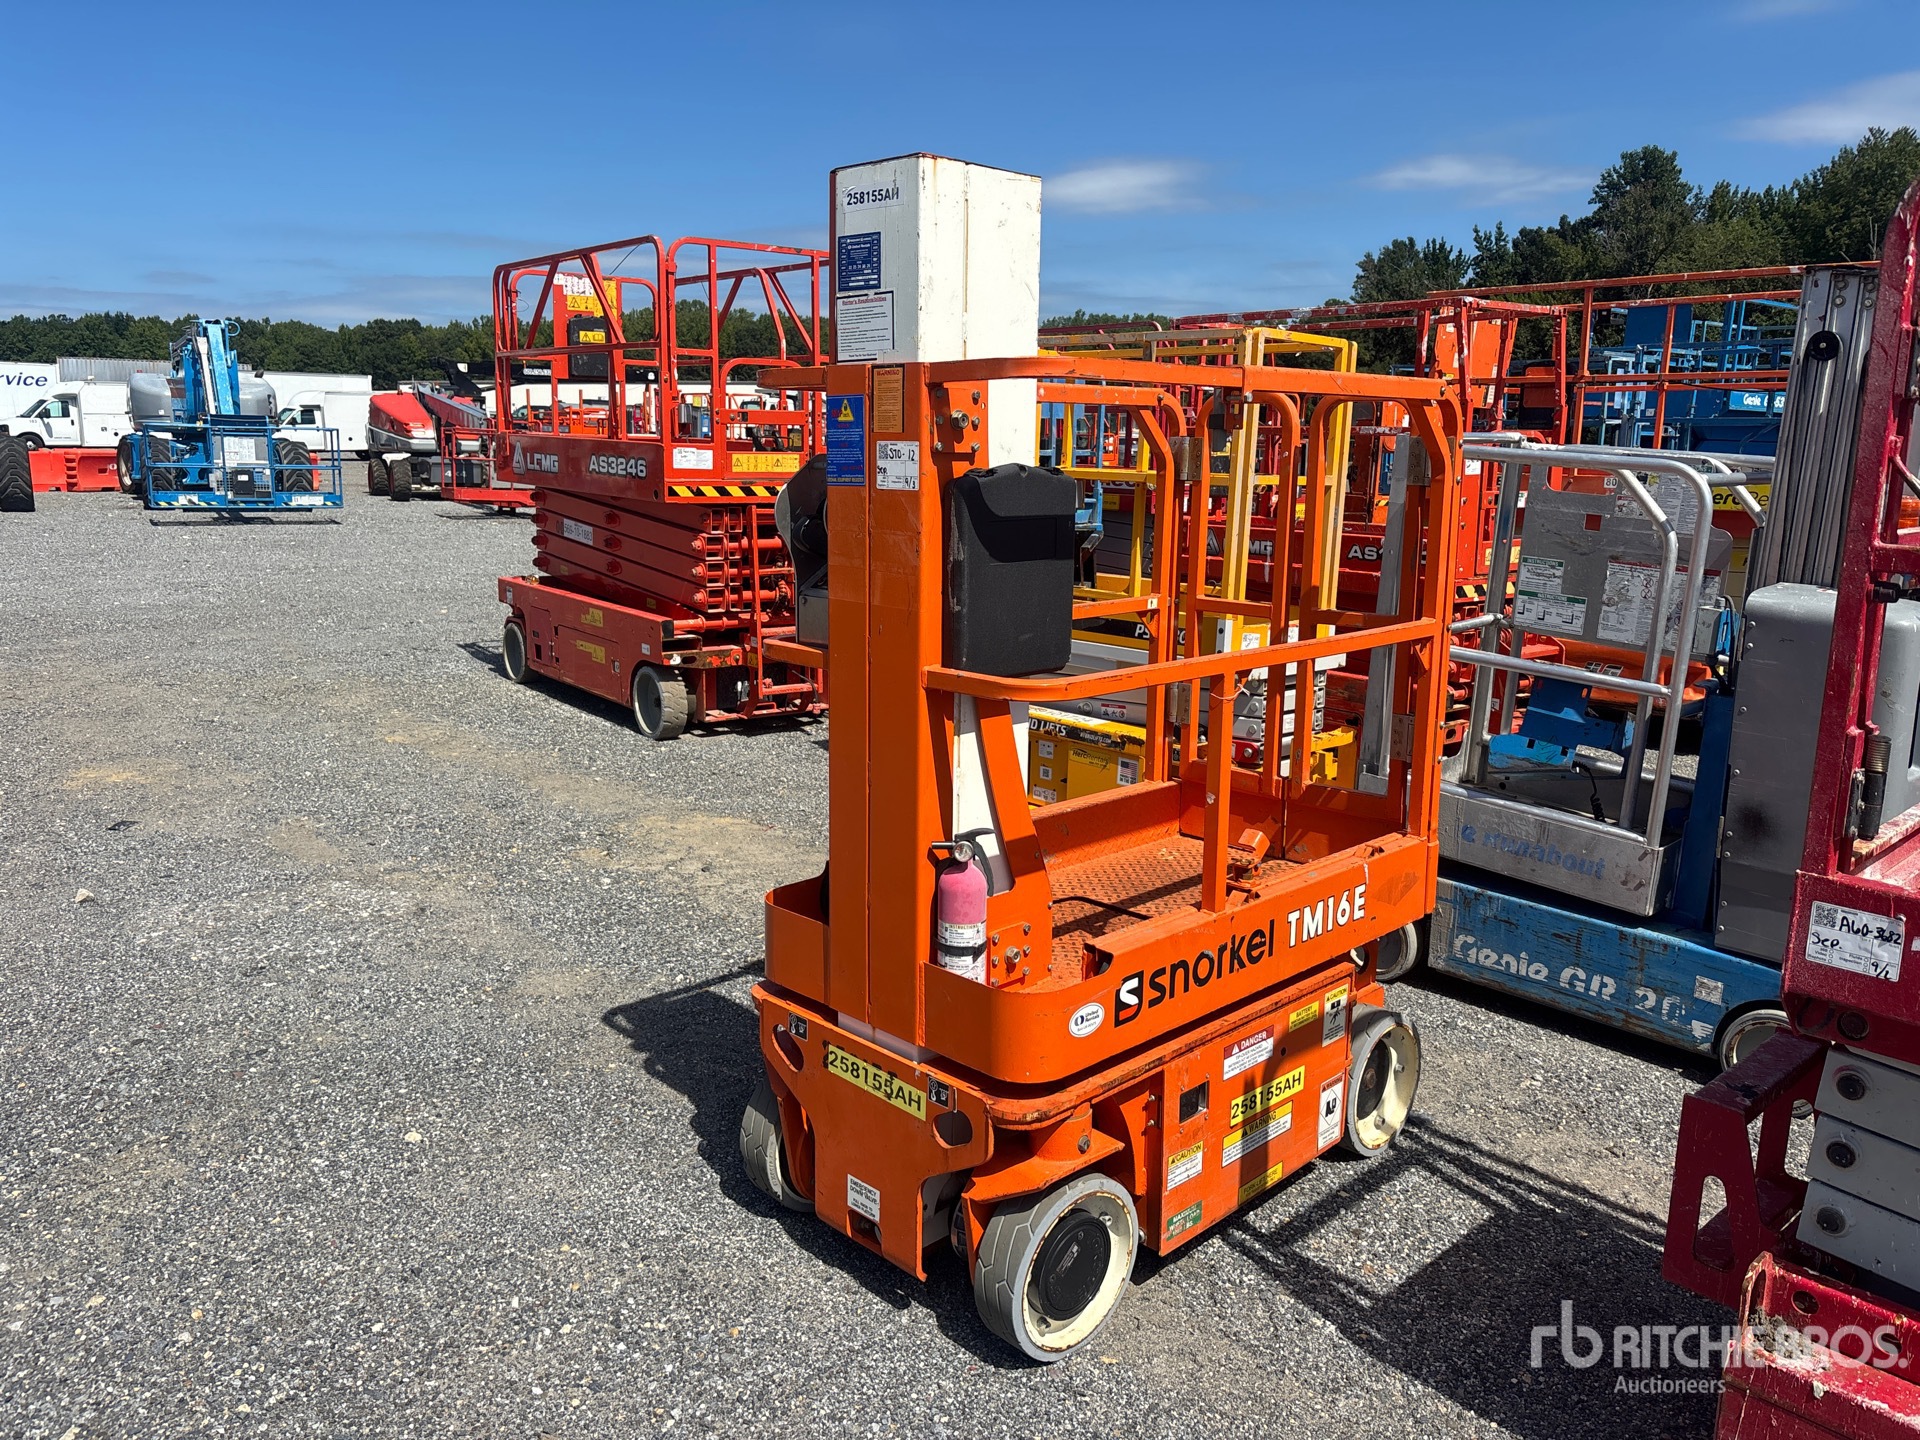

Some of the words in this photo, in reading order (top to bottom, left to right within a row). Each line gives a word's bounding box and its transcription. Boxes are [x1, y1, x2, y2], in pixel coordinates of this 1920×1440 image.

[846, 187, 899, 206] 258155AH
[588, 454, 648, 478] AS3246
[904, 476, 916, 489] 9/3
[1605, 477, 1618, 488] 80
[1526, 557, 1559, 566] INSTRUCTIONS
[1537, 593, 1567, 601] INSTRUCTIONS
[1287, 882, 1366, 948] TM16E
[1148, 919, 1274, 1009] snorkel
[1453, 934, 1549, 984] Genie
[1329, 988, 1347, 1000] CAUTION
[1295, 1005, 1313, 1018] BATTERY
[1240, 1031, 1267, 1050] DANGER
[828, 1051, 921, 1112] 258155AH
[1231, 1071, 1302, 1120] 258155AH
[1249, 1110, 1277, 1132] WARNING
[1176, 1143, 1202, 1162] CAUTION
[850, 1178, 877, 1197] EMERGENCY
[850, 1185, 864, 1197] DOWN
